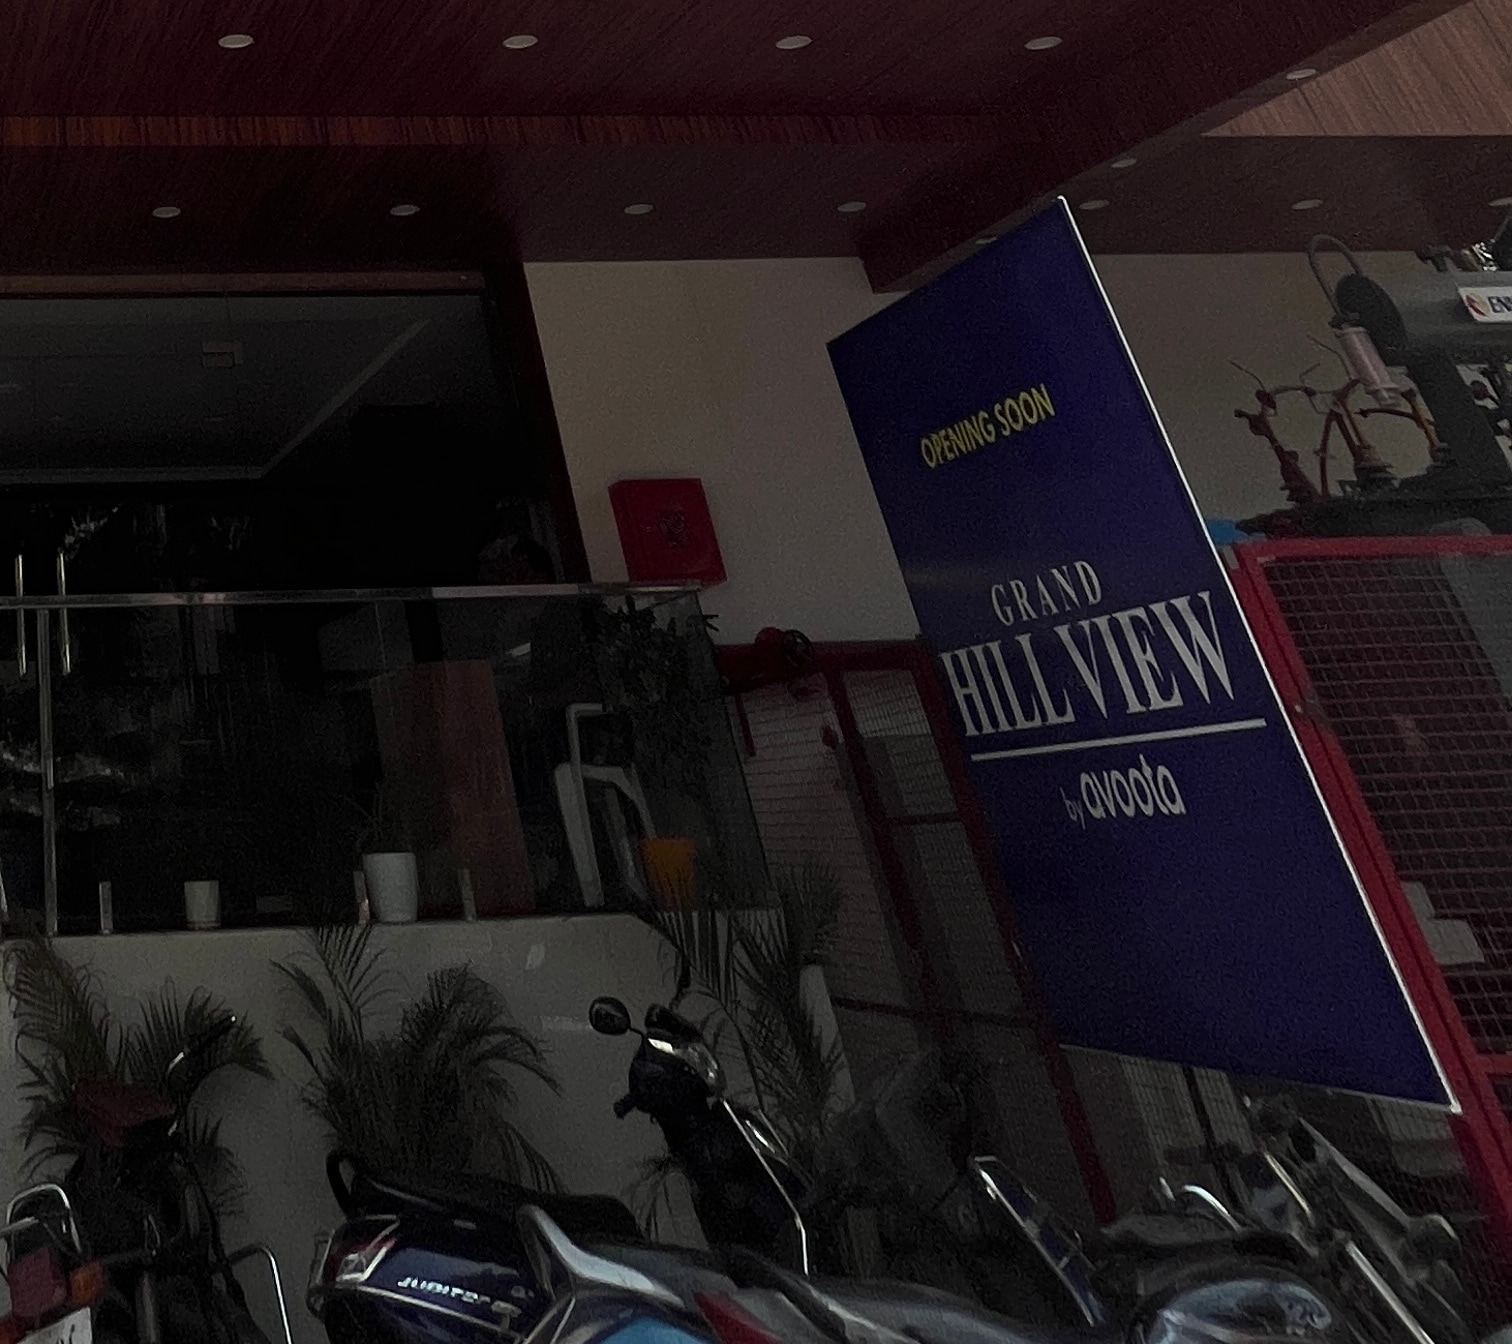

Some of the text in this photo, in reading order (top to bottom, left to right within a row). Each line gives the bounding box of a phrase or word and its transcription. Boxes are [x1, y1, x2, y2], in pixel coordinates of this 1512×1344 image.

[920, 382, 1056, 469] OPENING SOON
[990, 560, 1102, 627] GRAND
[940, 590, 1235, 737] HILL VIEW
[1059, 753, 1187, 831] by avoota
